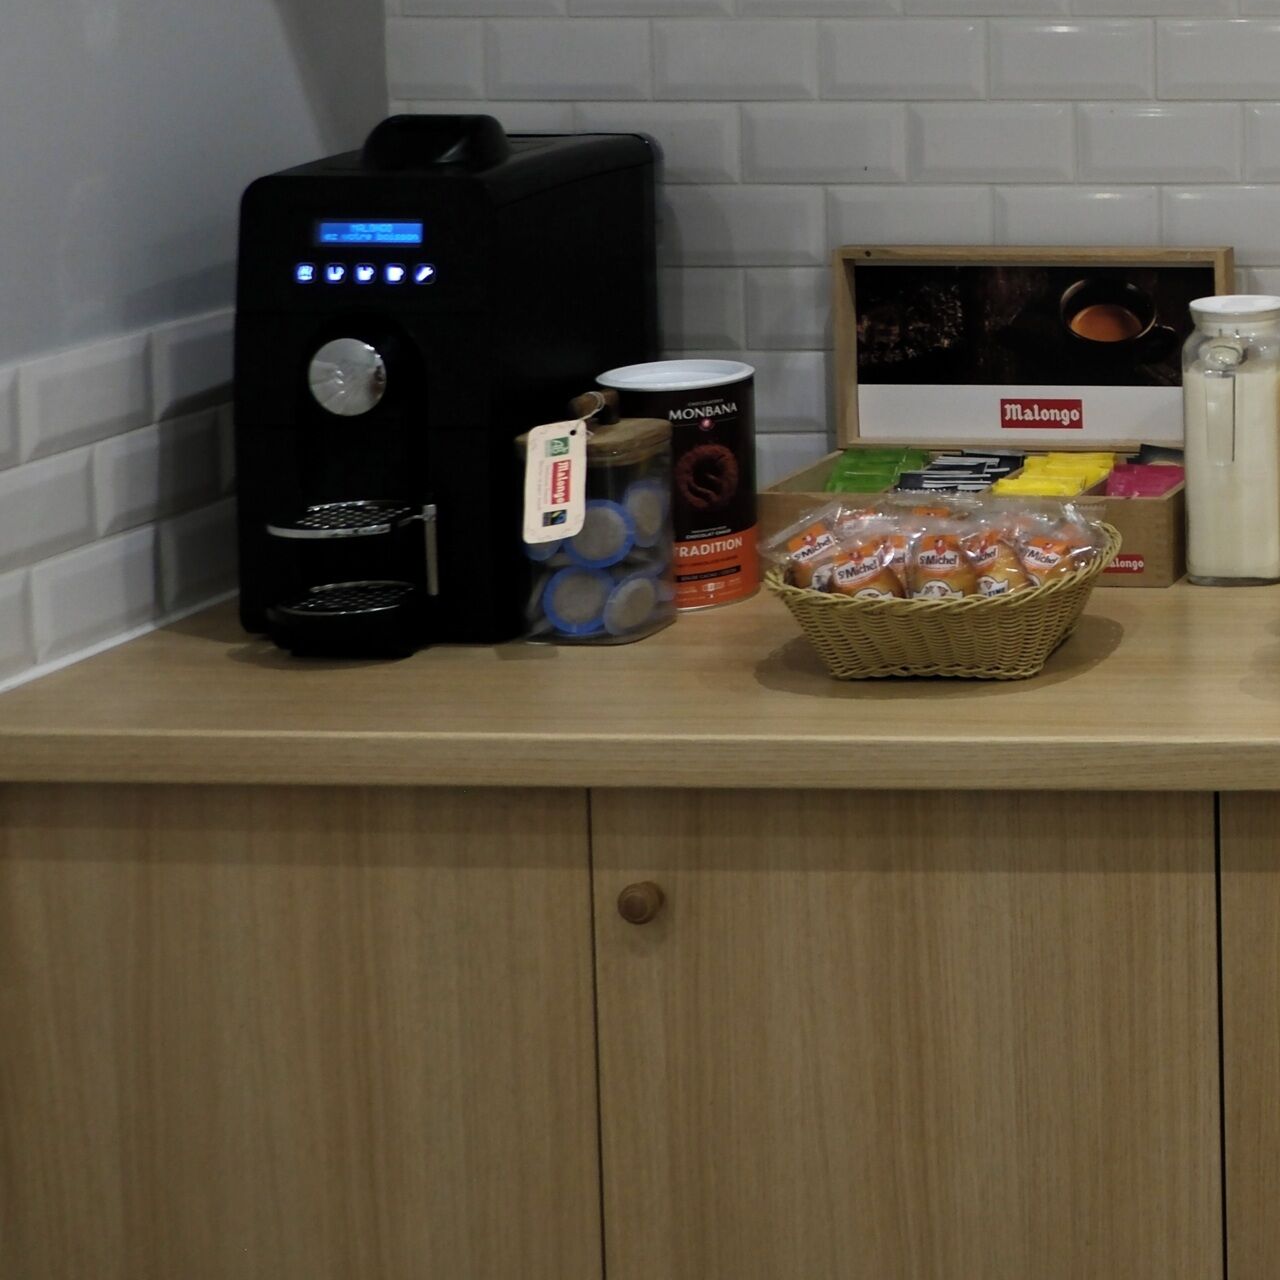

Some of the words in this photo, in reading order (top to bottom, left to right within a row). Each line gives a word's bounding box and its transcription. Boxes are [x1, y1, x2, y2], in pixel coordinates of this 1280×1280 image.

[669, 402, 738, 421] MONBANA
[1004, 404, 1080, 426] Malongo
[552, 460, 570, 504] Malongo
[1108, 559, 1144, 571] alongo
